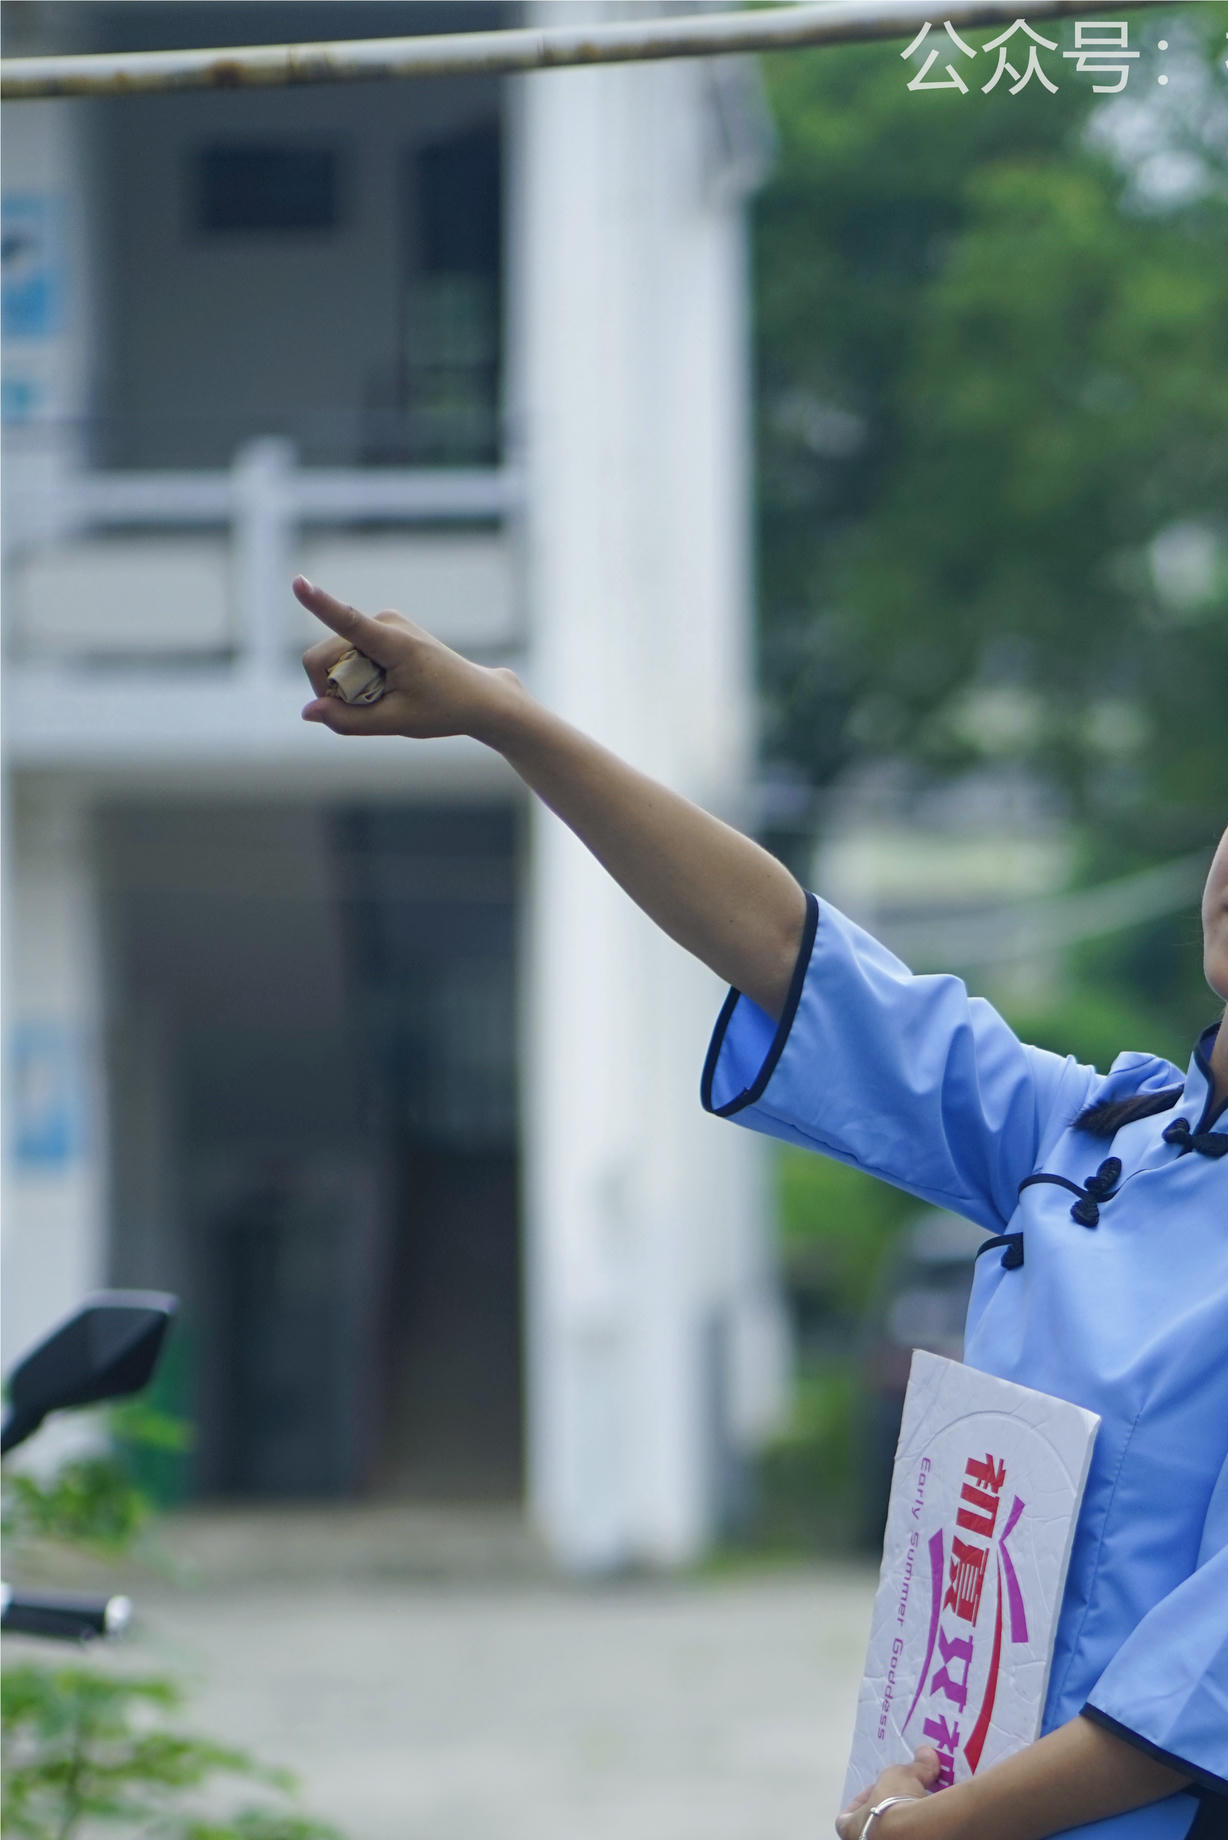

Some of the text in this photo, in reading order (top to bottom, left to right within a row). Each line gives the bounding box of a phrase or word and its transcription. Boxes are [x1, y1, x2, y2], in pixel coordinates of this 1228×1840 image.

[877, 1456, 931, 1740] Early Summer Goddess
